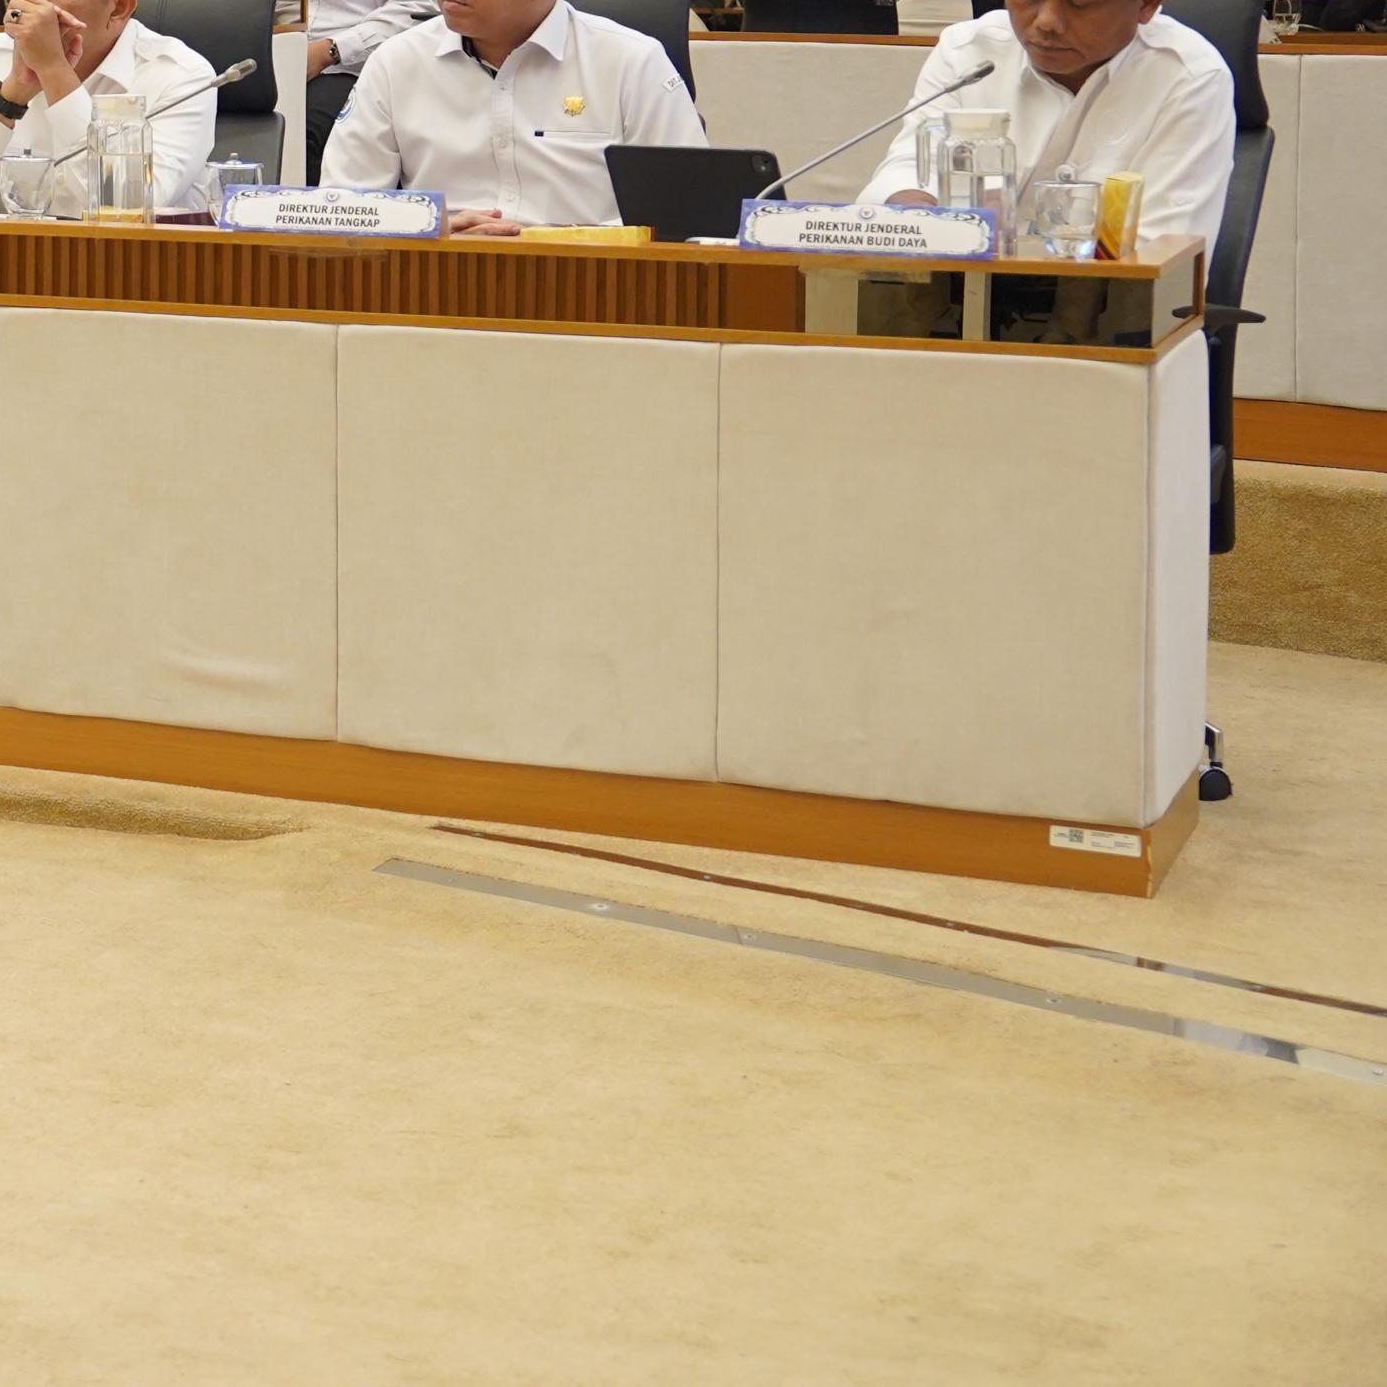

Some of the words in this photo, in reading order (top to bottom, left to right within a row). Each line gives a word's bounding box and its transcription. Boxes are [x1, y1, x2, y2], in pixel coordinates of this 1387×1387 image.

[278, 204, 328, 214] DIREKTUR
[329, 206, 379, 216] JENDERAL
[276, 215, 332, 226] PERIKANAN
[334, 217, 380, 228] TANGKAP
[806, 221, 863, 233] DIREKTUR
[864, 223, 922, 235] JENDERAL
[799, 233, 864, 245] PERIKANAN
[867, 235, 895, 247] BUDI
[898, 236, 928, 248] DAYA
